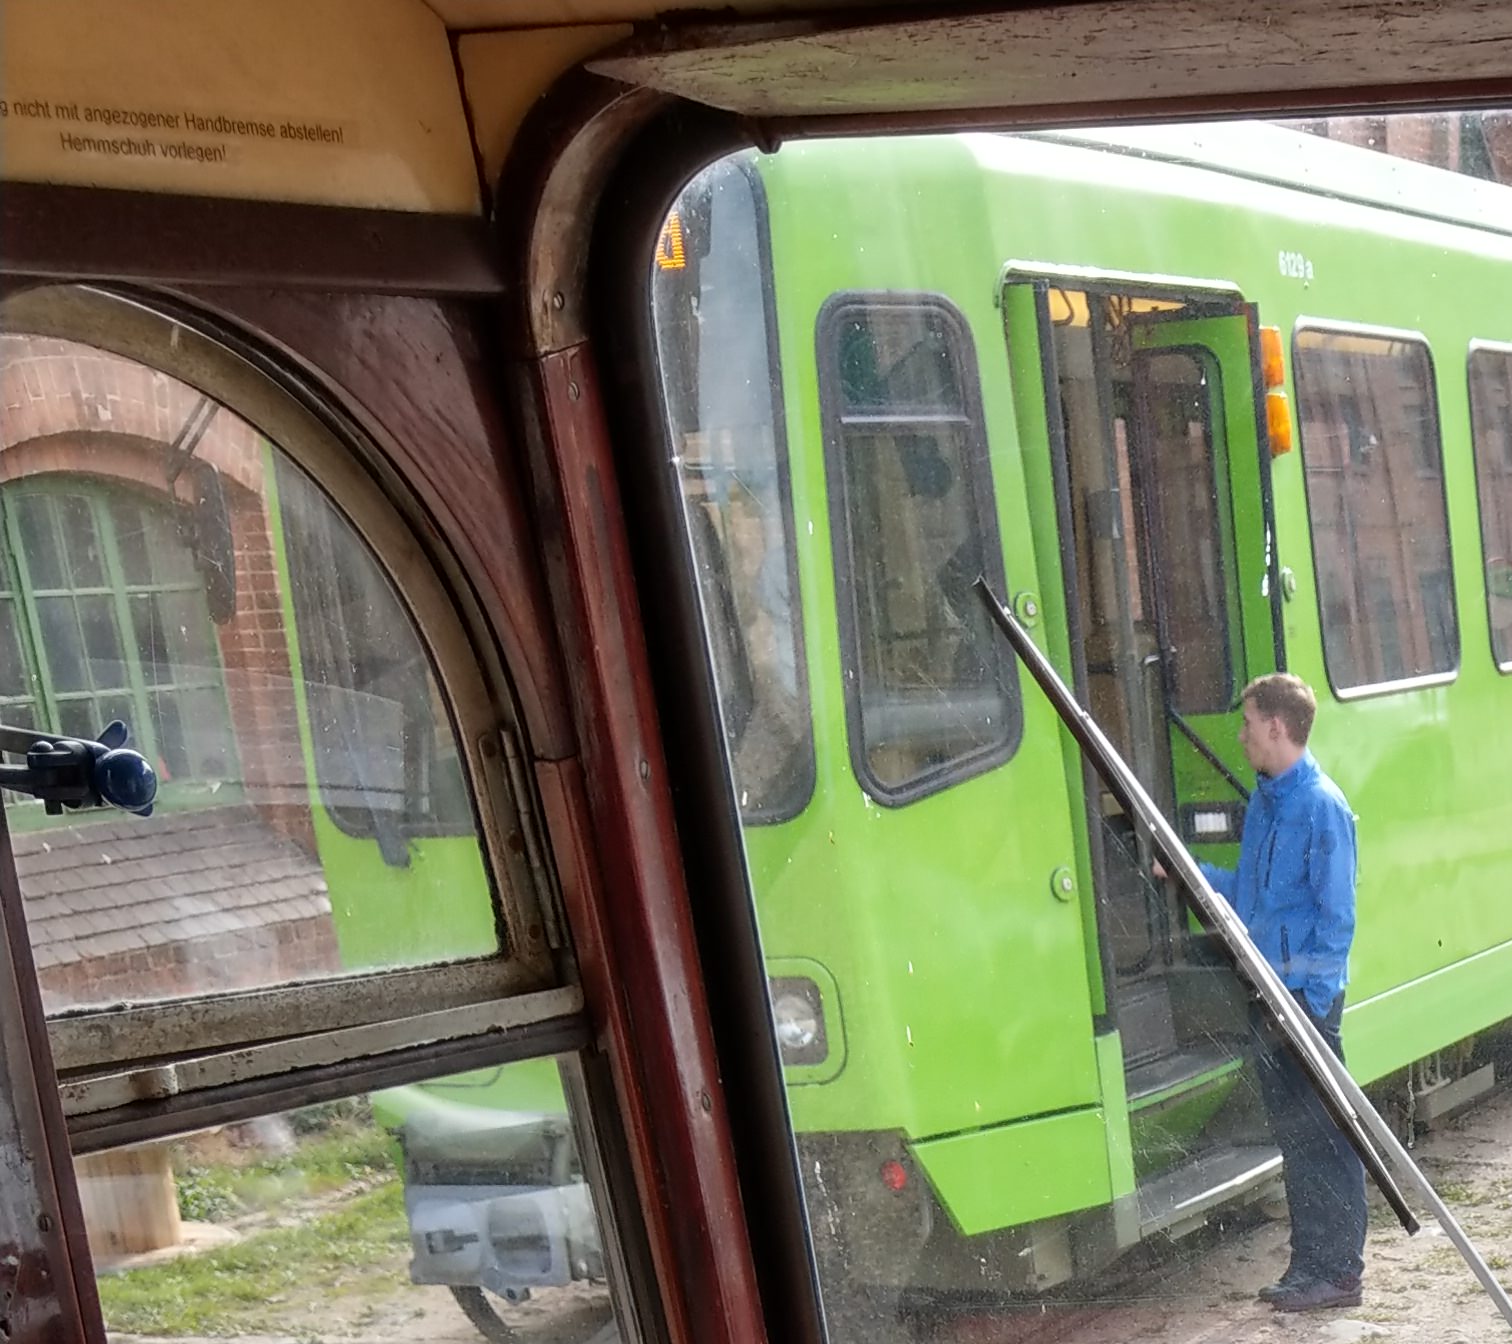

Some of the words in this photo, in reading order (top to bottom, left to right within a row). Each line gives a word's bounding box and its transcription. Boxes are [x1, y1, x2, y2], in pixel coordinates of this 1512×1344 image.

[13, 99, 52, 120] nicht
[55, 104, 80, 122] mit
[84, 105, 180, 130] angezogener
[184, 111, 276, 138] Handbremse
[280, 124, 344, 145] abstellen!
[59, 131, 156, 159] Hemmschuh
[160, 142, 226, 163] vorlegen!
